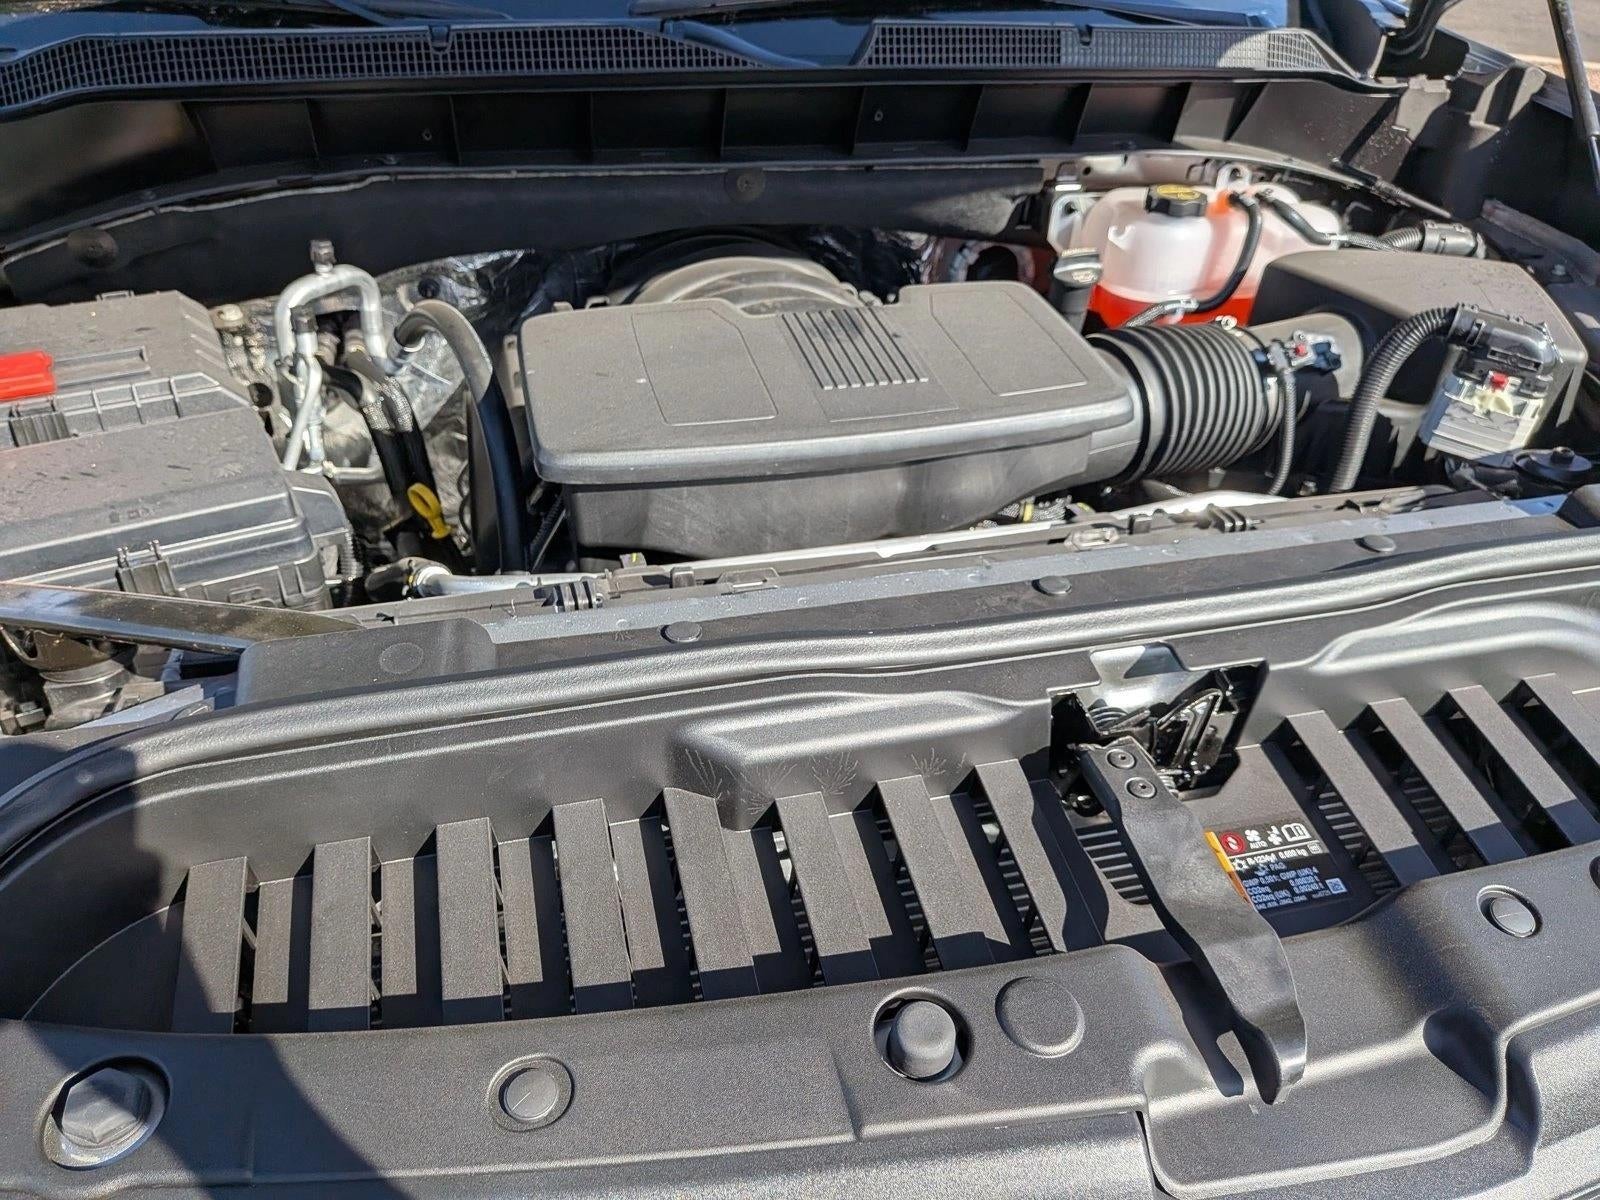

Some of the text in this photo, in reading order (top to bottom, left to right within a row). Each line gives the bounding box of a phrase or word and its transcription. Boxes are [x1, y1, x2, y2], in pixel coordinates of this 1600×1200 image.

[1250, 840, 1268, 849] AUTO
[1297, 849, 1308, 857] kg
[1243, 878, 1260, 888] GWP
[1280, 870, 1296, 879] GWP
